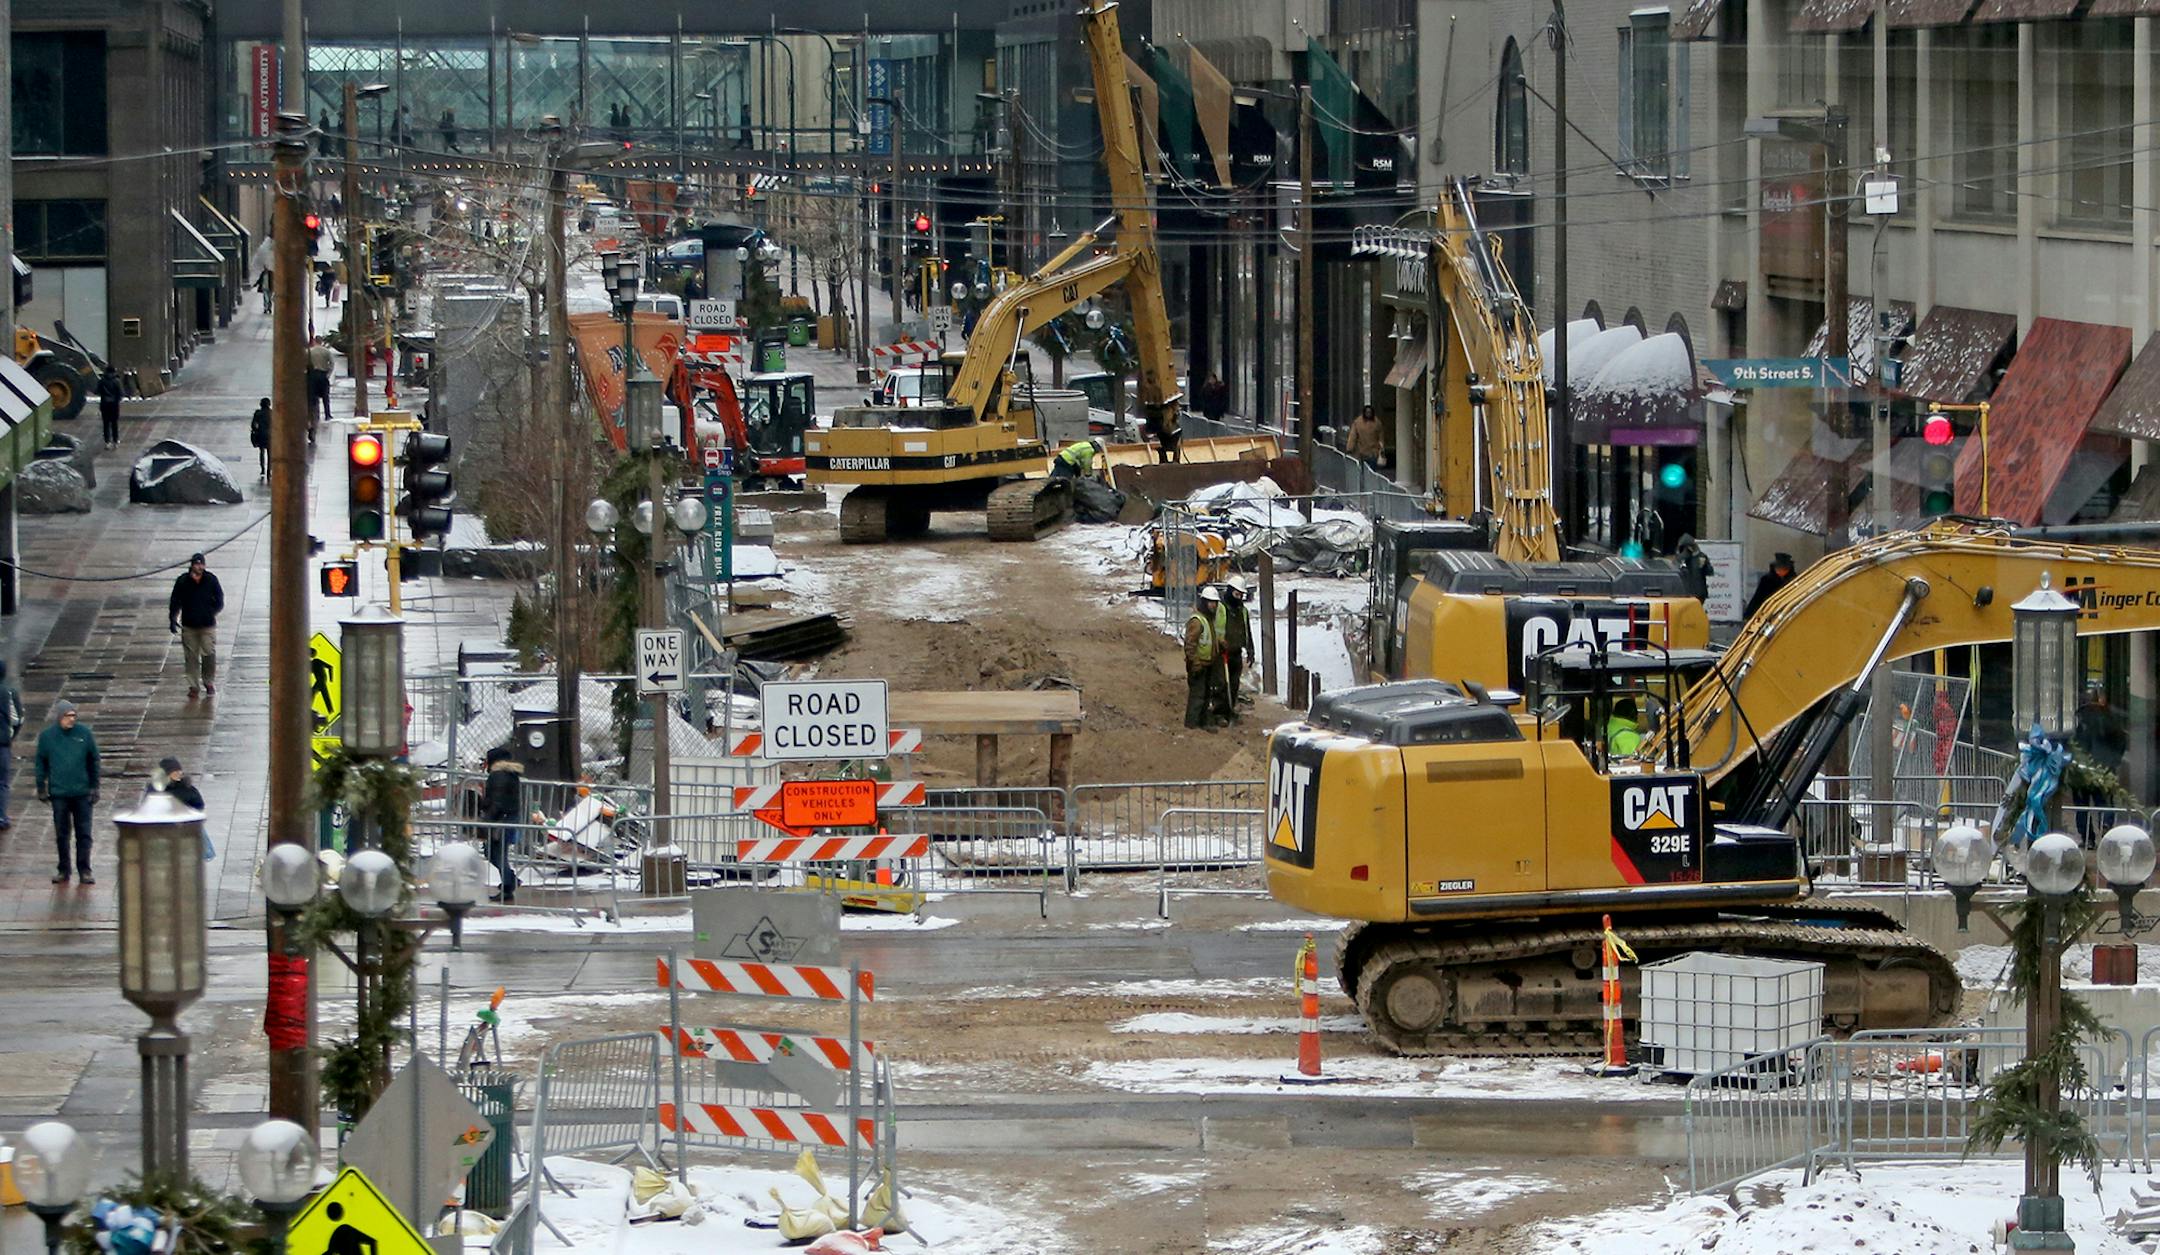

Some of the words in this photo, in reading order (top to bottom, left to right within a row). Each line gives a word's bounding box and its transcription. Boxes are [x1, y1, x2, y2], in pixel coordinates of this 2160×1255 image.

[260, 48, 270, 110] AUTHORITY
[1253, 154, 1272, 163] RSM
[1373, 158, 1392, 168] RSM
[699, 304, 727, 313] ROAD
[694, 315, 732, 324] CLOSED
[1733, 366, 1757, 380] 9th
[1759, 366, 1800, 380] Street
[1801, 367, 1814, 380] S.
[829, 457, 890, 470] CATERPILLAR
[714, 505, 722, 527] FREE
[714, 530, 722, 552] RIDE
[714, 556, 722, 576] BUS
[644, 636, 677, 651] ONE
[1522, 616, 1631, 678] CAT
[644, 653, 679, 667] WAY
[788, 692, 861, 716] ROAD
[775, 724, 876, 748] CLOSED
[785, 785, 870, 797] CONSTRUCTION
[801, 798, 856, 809] VEHICLES
[1267, 757, 1312, 853] CAT
[1623, 785, 1690, 831] CAT
[814, 811, 842, 821] ONLY
[1650, 834, 1691, 854] 329E
[1440, 880, 1474, 891] ZIEGLER
